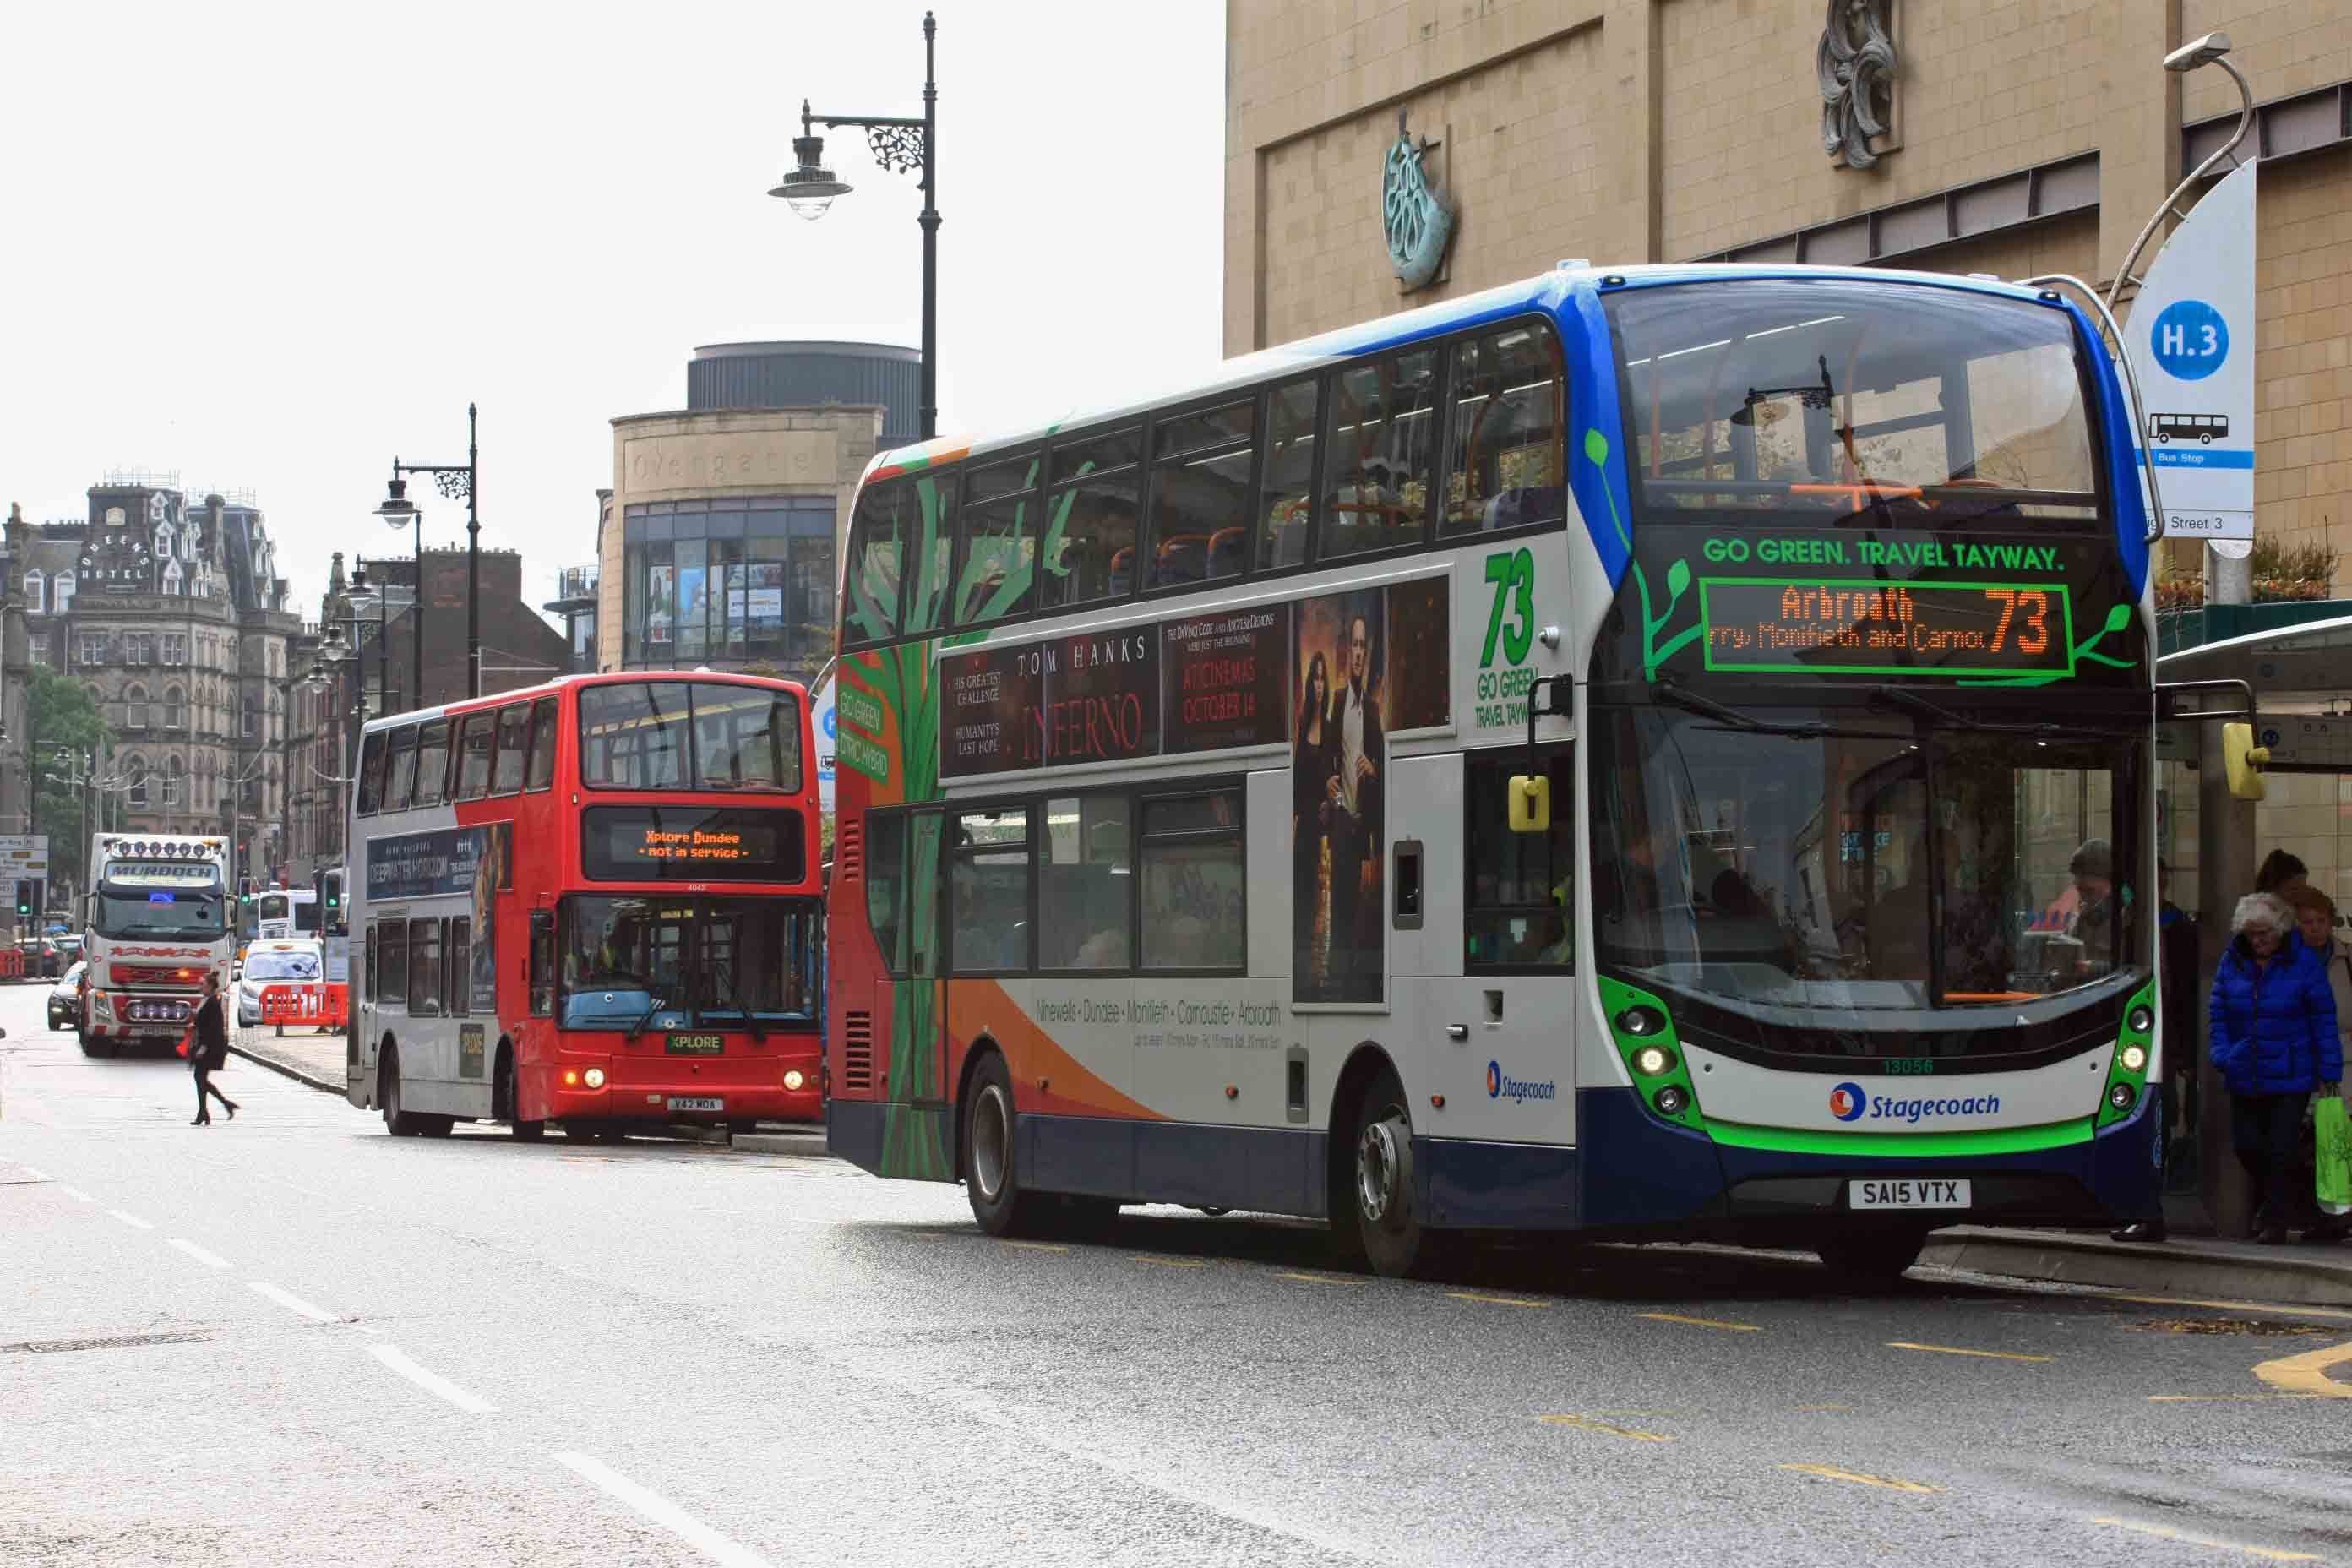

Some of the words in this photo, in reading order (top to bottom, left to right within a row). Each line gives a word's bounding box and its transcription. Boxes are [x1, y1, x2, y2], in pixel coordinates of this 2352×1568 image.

[2163, 324, 2218, 357] H.3
[2158, 451, 2177, 463] Bus
[2180, 452, 2204, 465] Stop
[2170, 515, 2210, 530] Street
[2214, 516, 2224, 530] 3
[1703, 538, 1750, 564] GO
[1756, 538, 1853, 565] GREEN.
[1856, 540, 1949, 568] TRAVEL
[1952, 543, 2066, 572] TAYWAY.
[82, 569, 143, 580] HOTEL
[1479, 547, 1535, 669] 73
[1782, 584, 1914, 623] Arbroath
[1758, 621, 1860, 651] Monifieth
[1867, 622, 1907, 650] and
[1986, 587, 2048, 656] 73
[1017, 649, 1056, 677] TOM
[1074, 635, 1145, 669] HANKS
[954, 675, 966, 691] HIS
[966, 670, 1001, 689] GREATEST
[1202, 656, 1256, 689] CINEMAS
[1478, 672, 1497, 700] GO
[840, 691, 853, 717] GO
[854, 698, 879, 732] GREEN
[1183, 691, 1241, 724] OCTOBER
[1475, 704, 1505, 730] TRAVEL
[1022, 692, 1141, 760] INFERNO
[959, 741, 977, 755] LAST
[645, 830, 689, 844] Xplore
[694, 830, 740, 844] Dundee
[648, 847, 674, 858] not
[675, 847, 688, 858] in
[690, 847, 739, 858] service
[1036, 999, 1076, 1022] Ninewells
[1083, 998, 1119, 1024] Dundee
[1126, 999, 1170, 1025] Monifieth
[1177, 999, 1231, 1025] Carnoustie
[1237, 999, 1282, 1025] Arbroath
[670, 1035, 721, 1048] XPLORE
[1884, 1059, 1935, 1075] 13056
[1502, 1075, 1555, 1105] Stagecoach
[1870, 1094, 2001, 1124] Stagecoach
[1863, 1183, 1911, 1205] SA15
[1918, 1183, 1958, 1204] VTX
